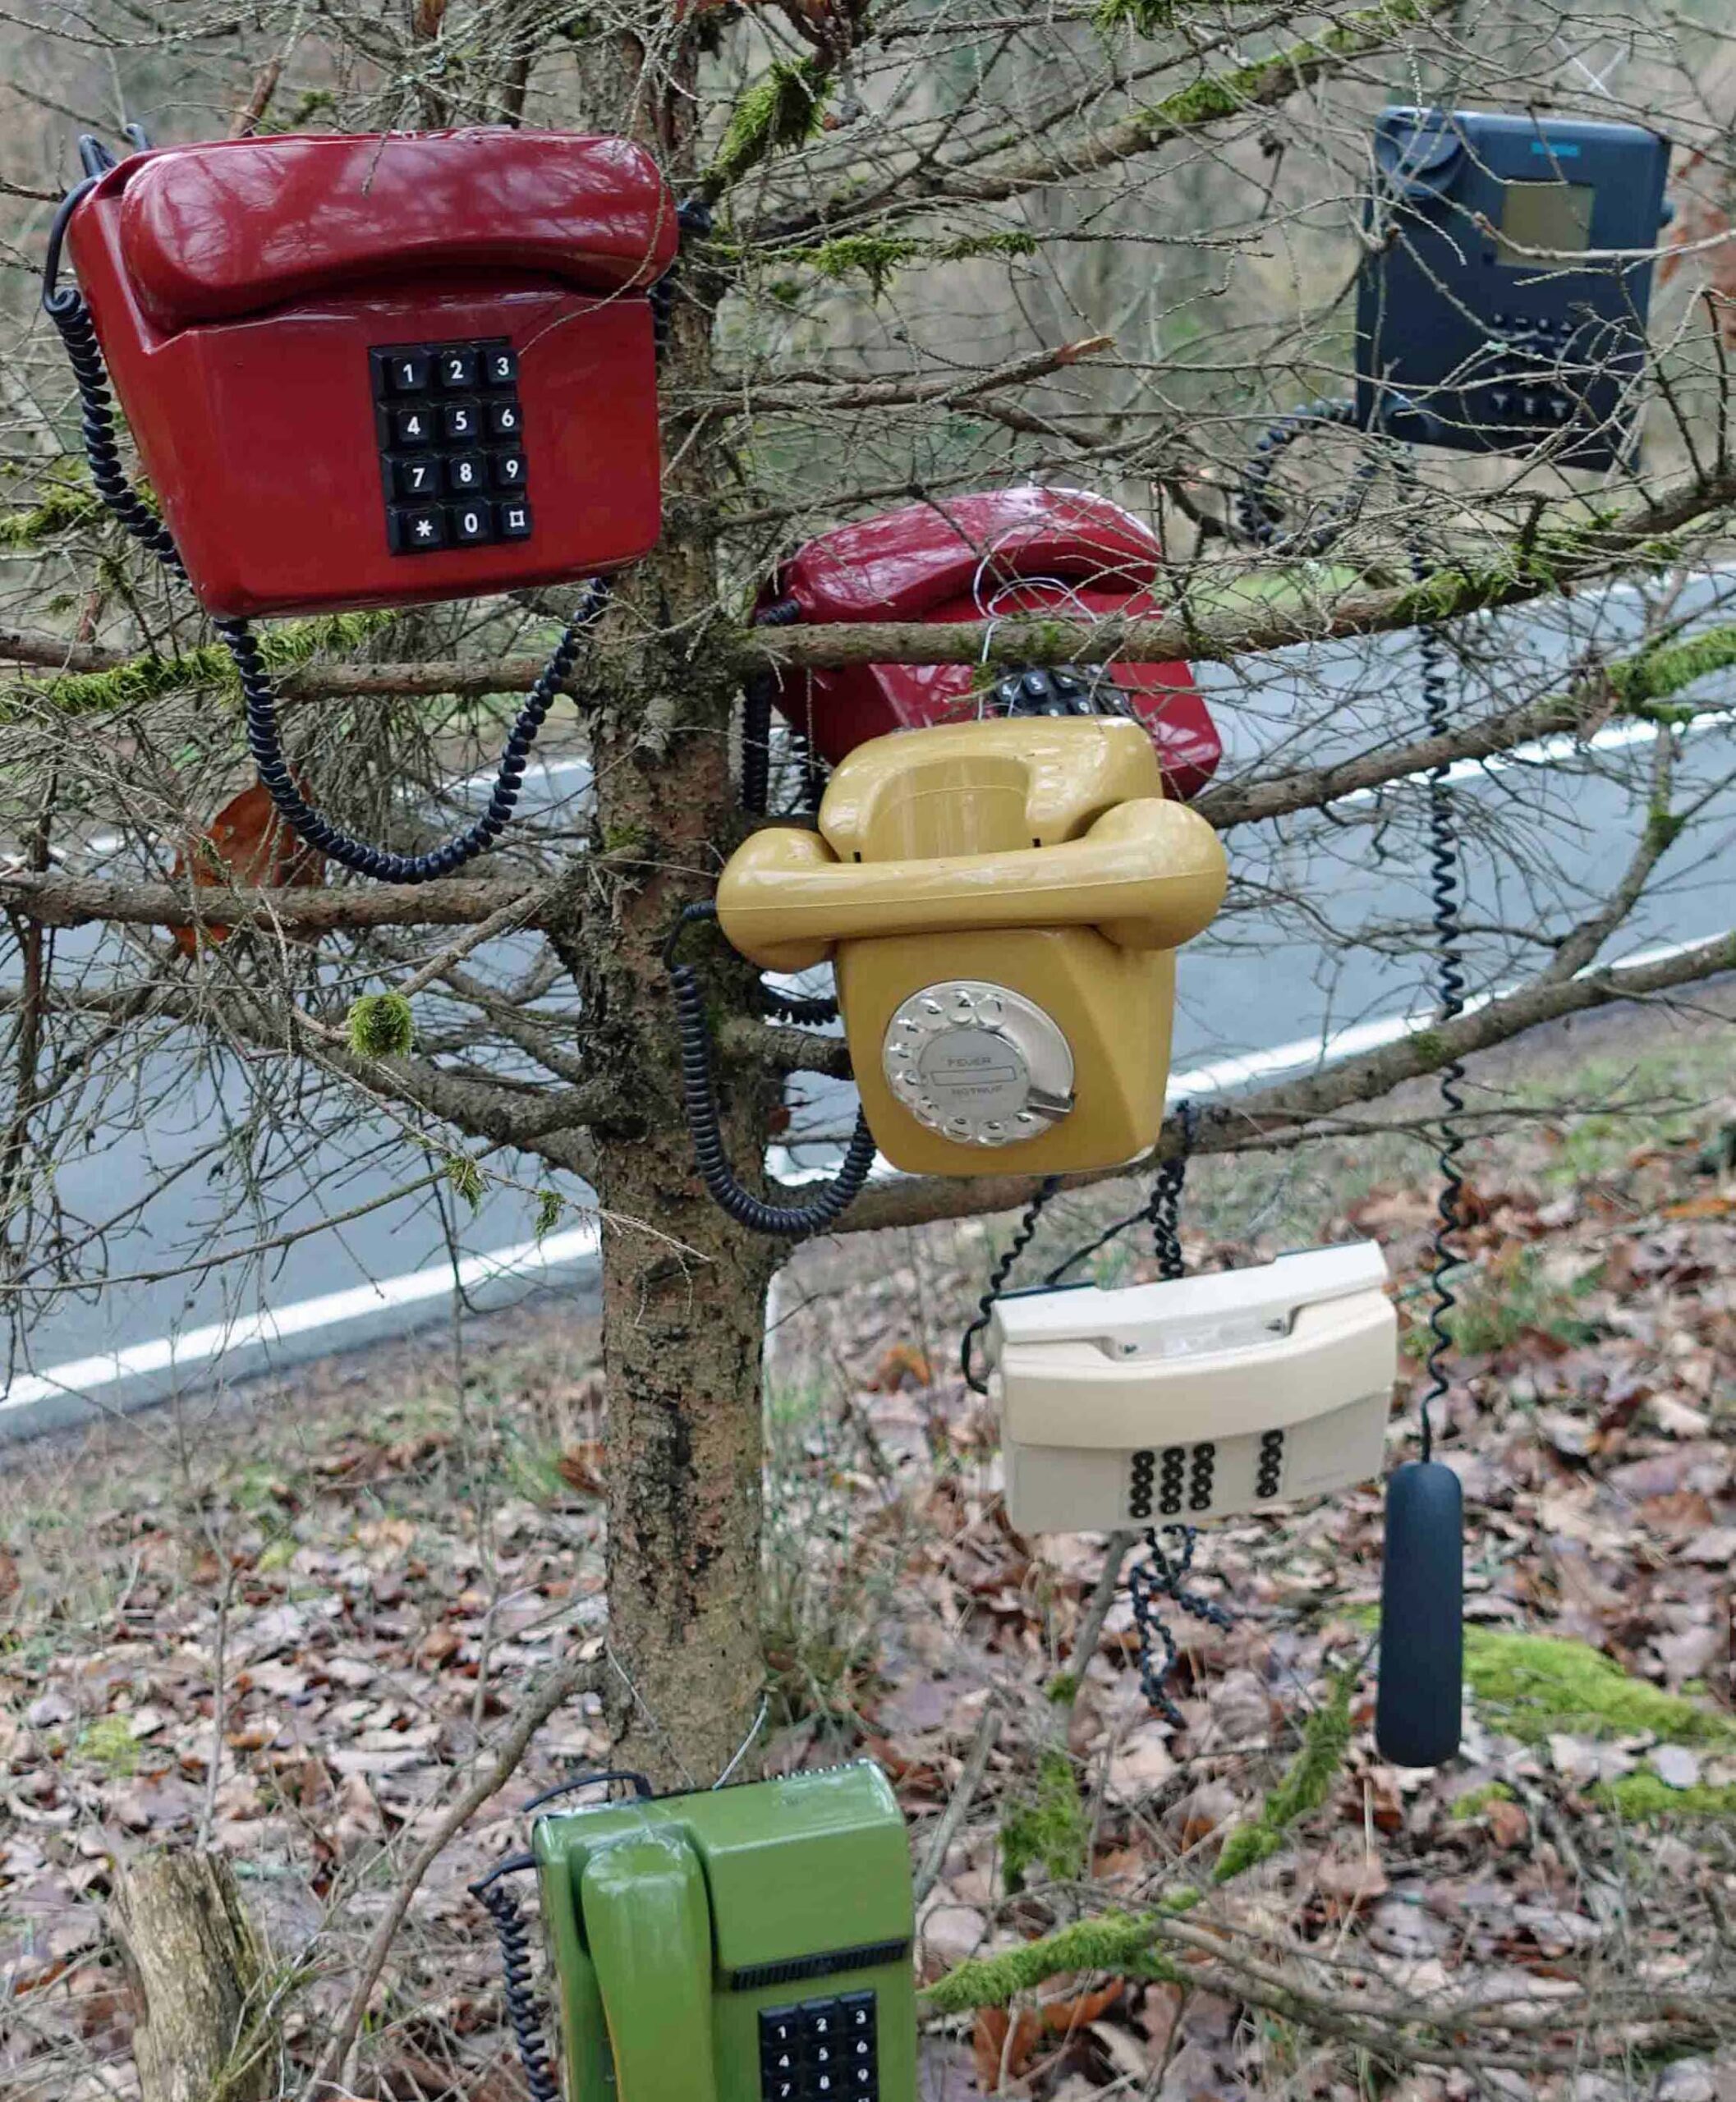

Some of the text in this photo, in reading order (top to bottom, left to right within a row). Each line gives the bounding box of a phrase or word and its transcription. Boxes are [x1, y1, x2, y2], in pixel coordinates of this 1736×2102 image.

[403, 356, 509, 383] 1 2 3
[407, 408, 515, 435] 4 5 6
[412, 460, 518, 488] 7 8 9
[464, 512, 478, 533] 0
[778, 2009, 866, 2039] 1 2 3
[778, 2040, 868, 2068] 4 5 6
